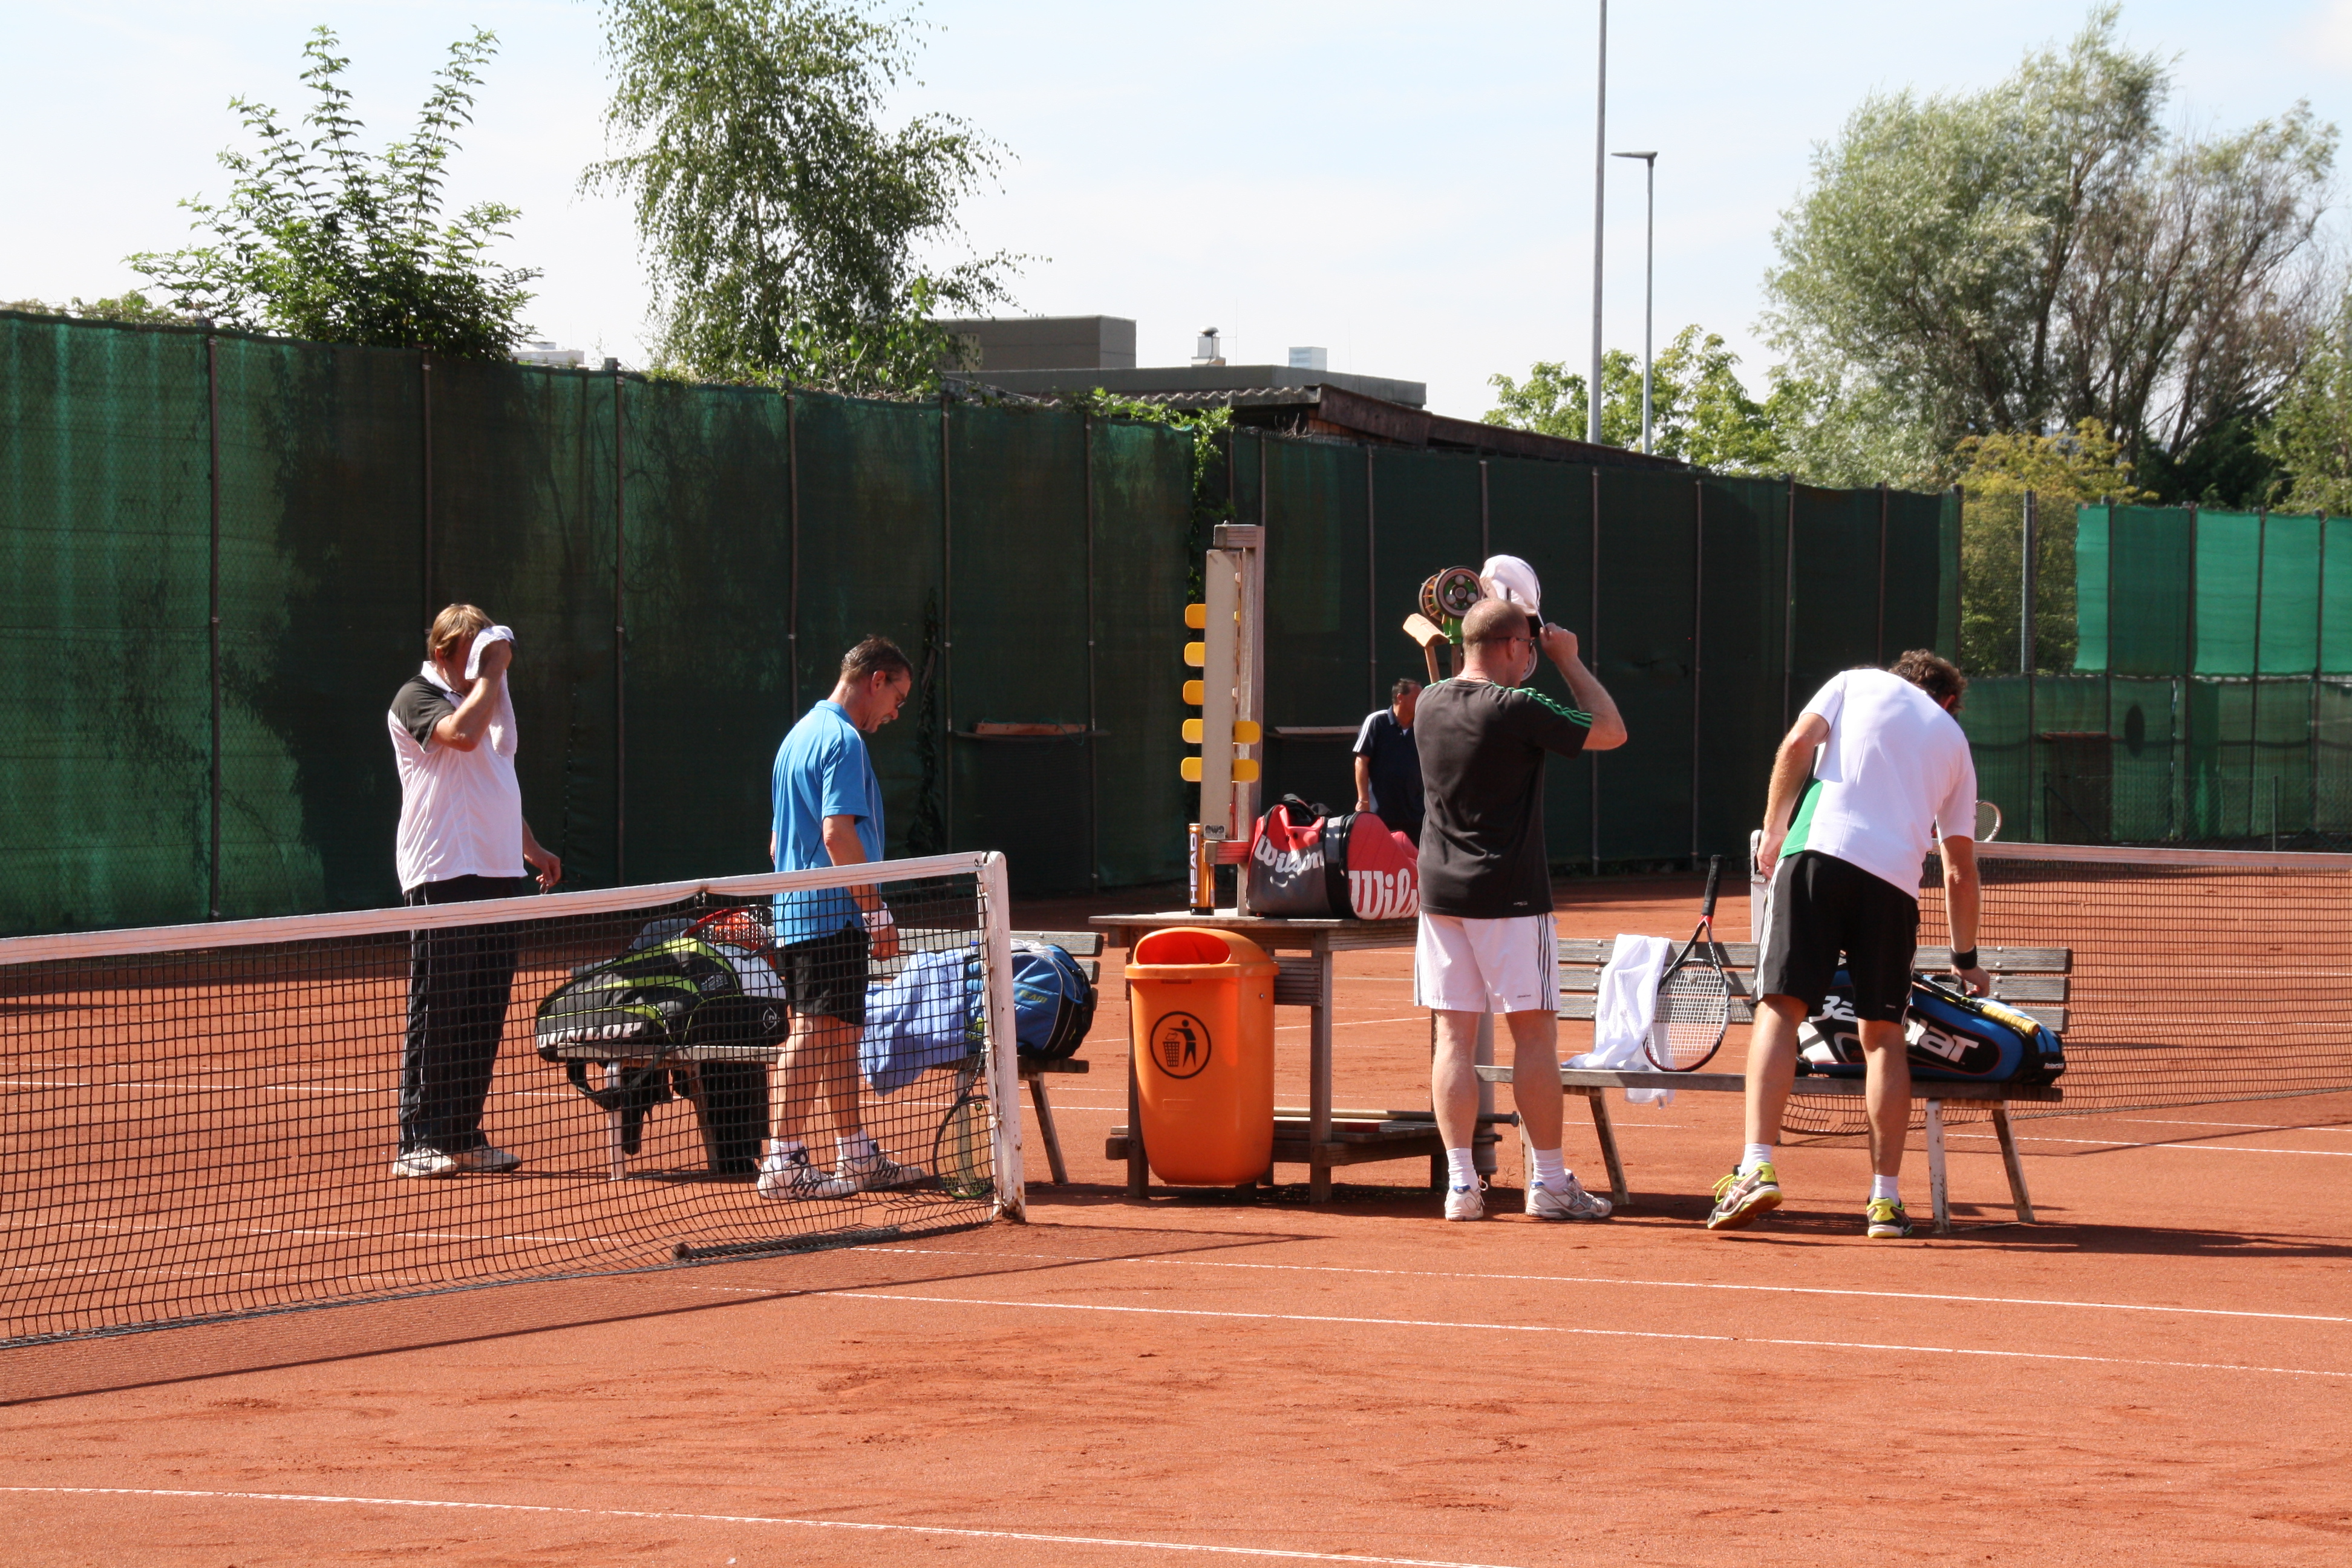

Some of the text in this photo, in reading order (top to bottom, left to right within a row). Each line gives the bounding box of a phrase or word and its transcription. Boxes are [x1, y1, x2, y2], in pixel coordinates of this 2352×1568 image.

[1255, 835, 1324, 875] Wilson
[1348, 868, 1420, 920] Wils
[536, 1022, 642, 1049] DUNLOP
